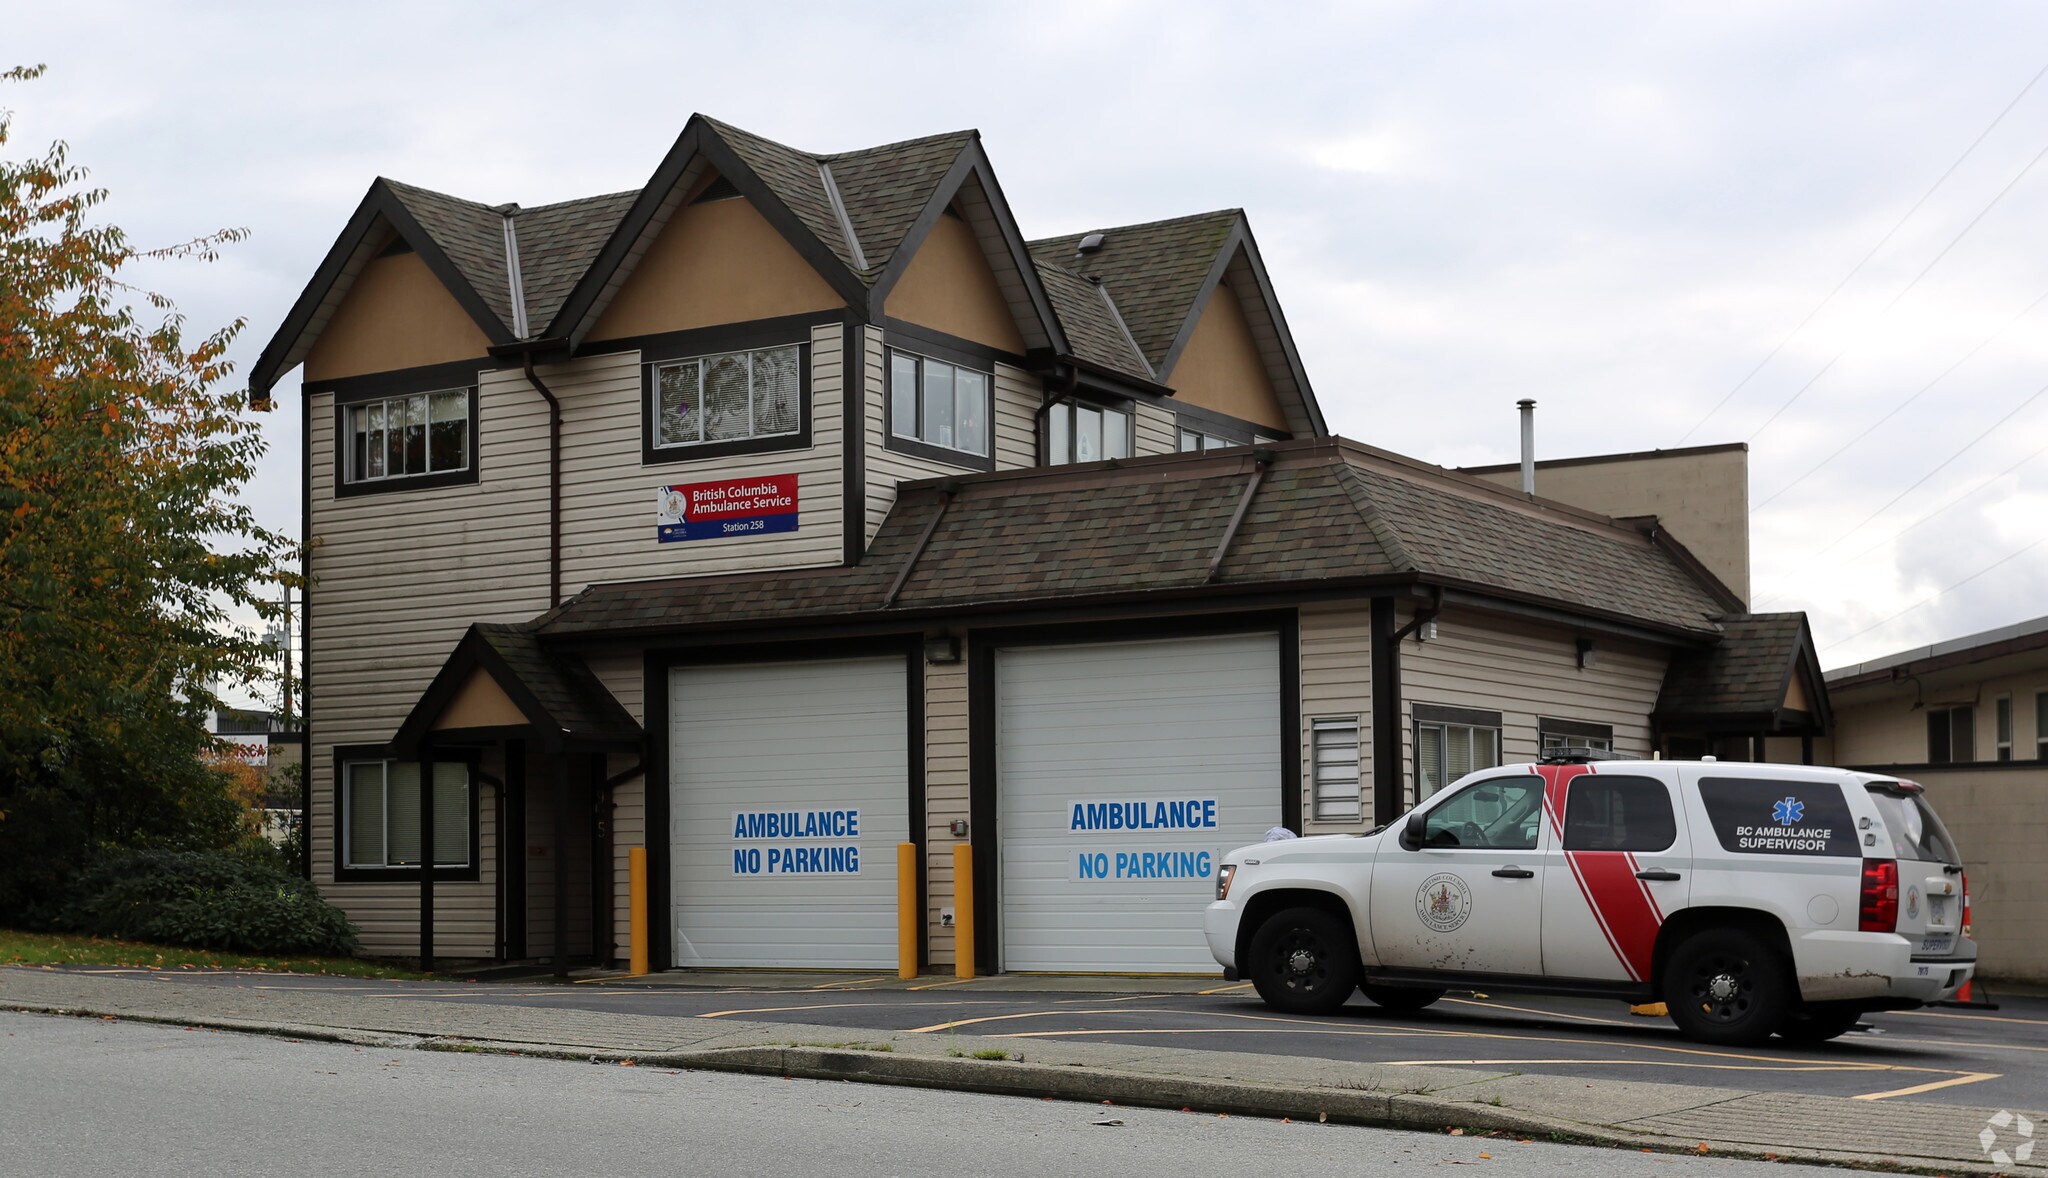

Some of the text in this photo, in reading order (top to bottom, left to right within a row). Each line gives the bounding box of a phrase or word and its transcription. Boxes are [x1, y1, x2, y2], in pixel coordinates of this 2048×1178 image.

[693, 483, 778, 502] British Columbia
[693, 495, 791, 514] Ambulance Service
[723, 520, 764, 533] Station 258
[734, 810, 859, 838] AMBULANCE
[1071, 800, 1216, 830] AMBULANCE
[1736, 826, 1832, 839] BC AMBULANCE
[1739, 837, 1826, 851] SUPERVISOR
[734, 847, 859, 874] NO PARKING
[1079, 851, 1211, 879] NO PARKING
[1421, 875, 1442, 893] BRITISH
